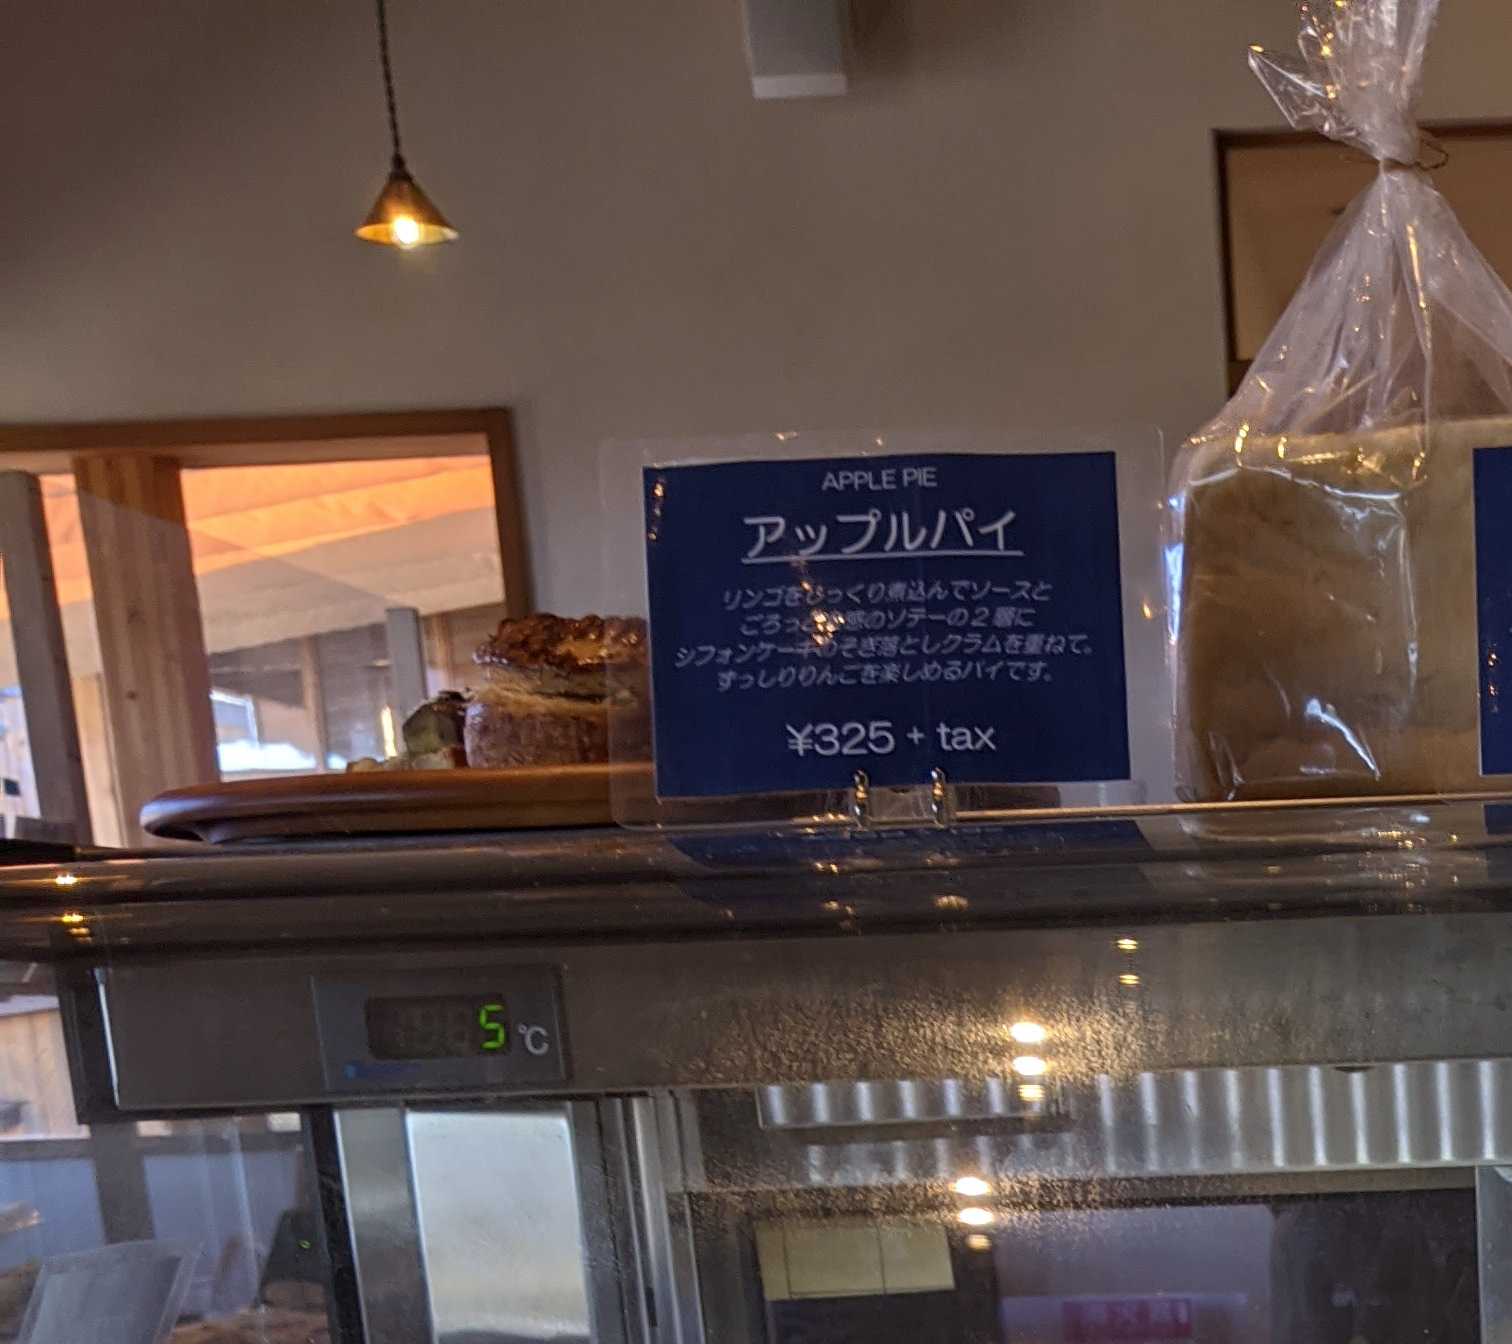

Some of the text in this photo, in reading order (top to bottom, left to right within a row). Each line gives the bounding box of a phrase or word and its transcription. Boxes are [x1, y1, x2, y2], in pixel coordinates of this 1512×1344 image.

[822, 469, 938, 491] APPLE PIE
[743, 510, 1017, 557] アップルパイ
[787, 722, 996, 755] ¥325 + tax
[478, 1004, 506, 1050] 5
